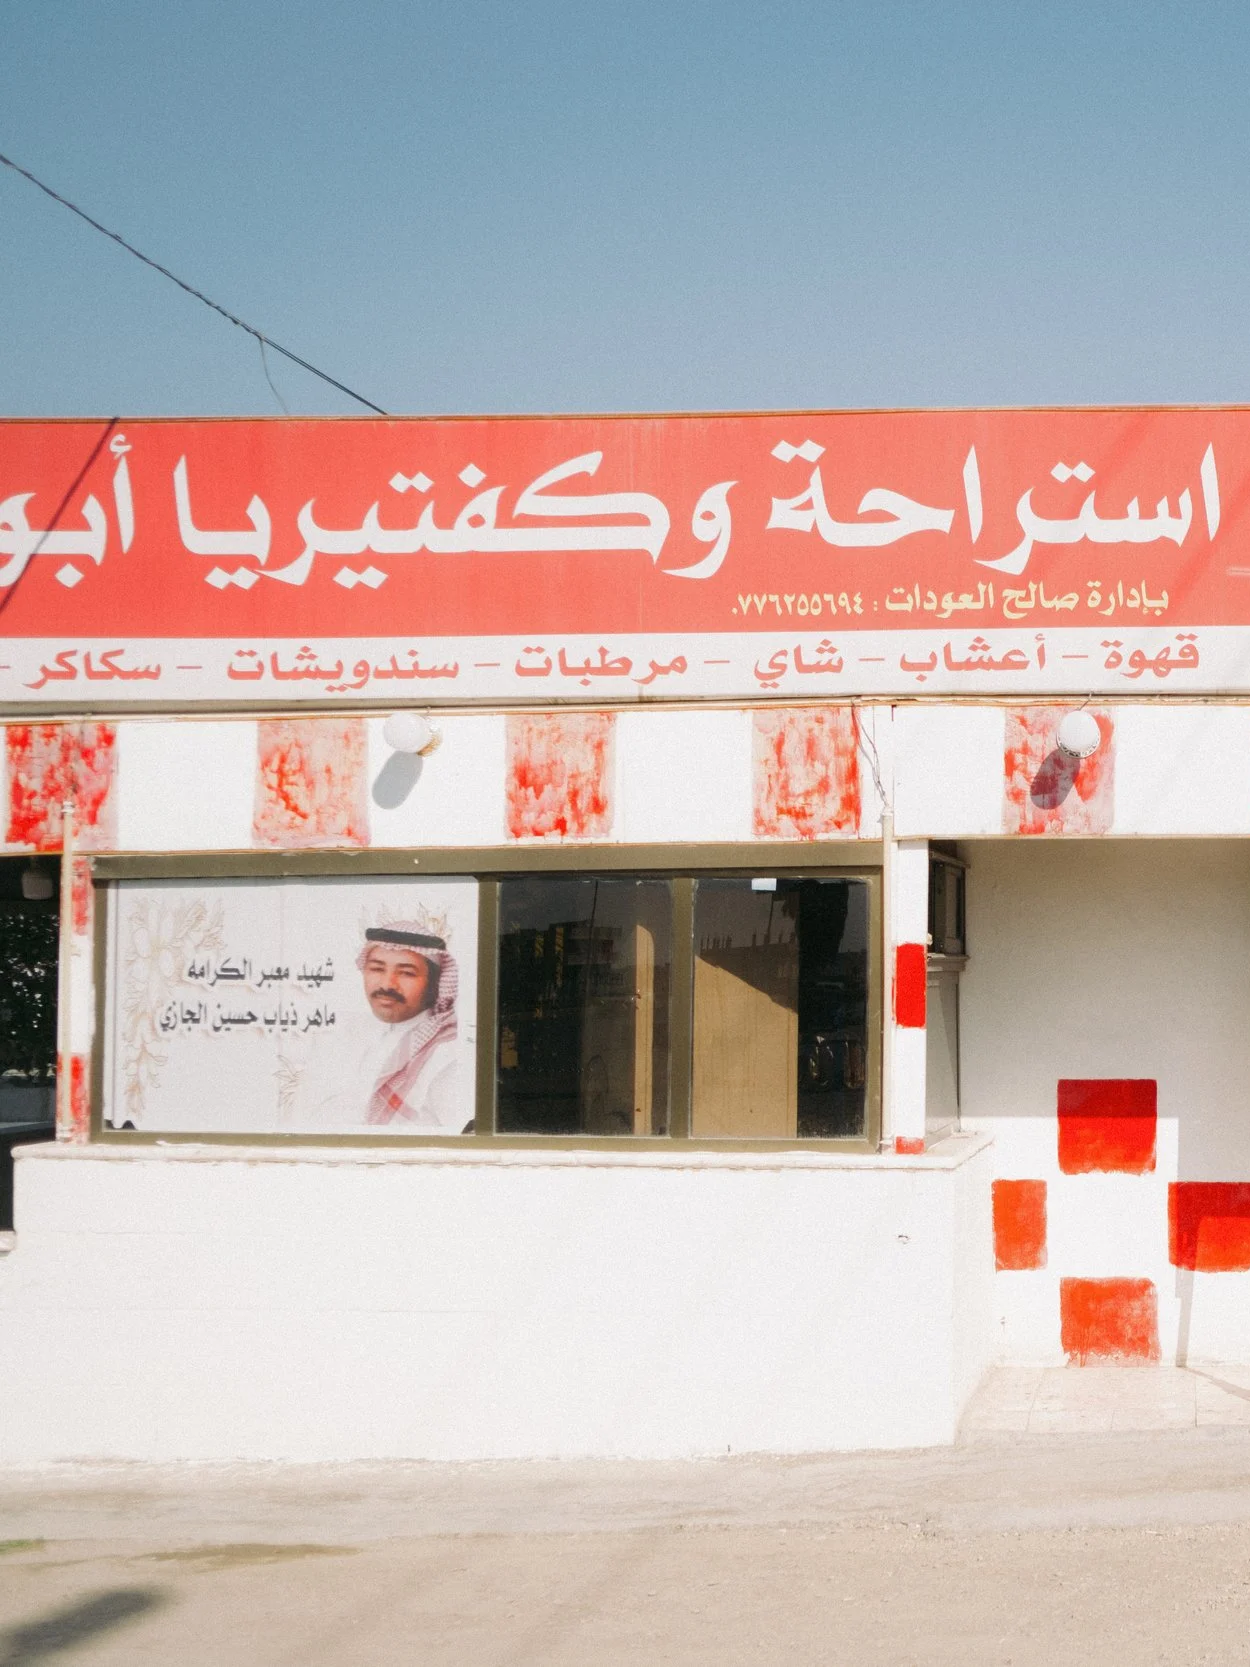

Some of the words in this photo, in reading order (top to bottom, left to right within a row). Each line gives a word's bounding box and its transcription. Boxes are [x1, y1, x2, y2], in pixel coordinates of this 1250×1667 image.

[173, 450, 738, 590] وكفتيريا
[766, 439, 1221, 576] استراحة
[885, 581, 995, 619] العودات
[1001, 580, 1080, 620] صالح
[1086, 579, 1169, 617] بإدارة
[22, 648, 162, 690] سكاكر
[226, 645, 460, 693] سندويشات
[514, 646, 689, 686] مرطبات
[753, 638, 844, 689] شاي
[900, 633, 1046, 683] أعشاب
[1100, 632, 1200, 679] قهوة
[256, 965, 290, 989] معبر
[297, 956, 335, 988] شهيد
[159, 1000, 208, 1033] الجازي
[212, 1002, 259, 1033] حسين
[302, 1002, 336, 1033] ماهر
